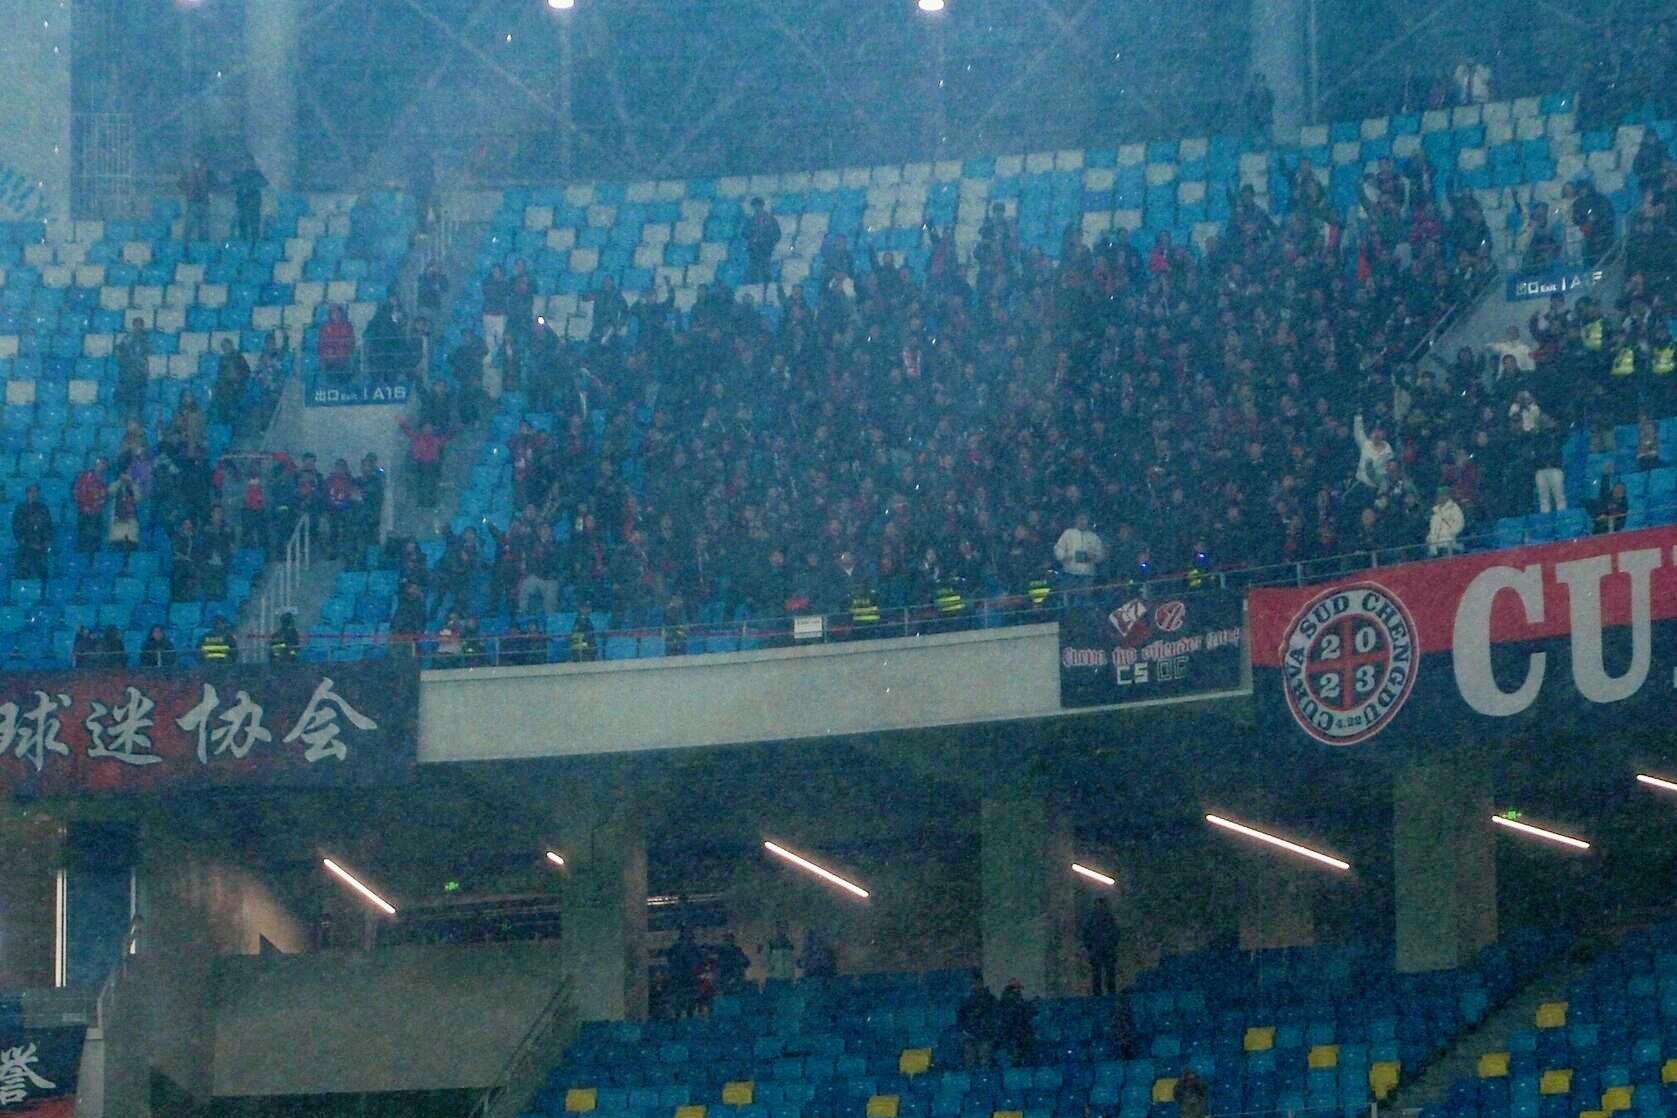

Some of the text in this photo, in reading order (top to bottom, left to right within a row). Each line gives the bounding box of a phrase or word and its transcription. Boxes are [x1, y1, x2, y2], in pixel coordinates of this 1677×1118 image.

[1300, 595, 1350, 640] SUD
[1361, 592, 1413, 725] CHENGDU
[1452, 545, 1677, 717] CU
[0, 677, 378, 772] 球迷协会
